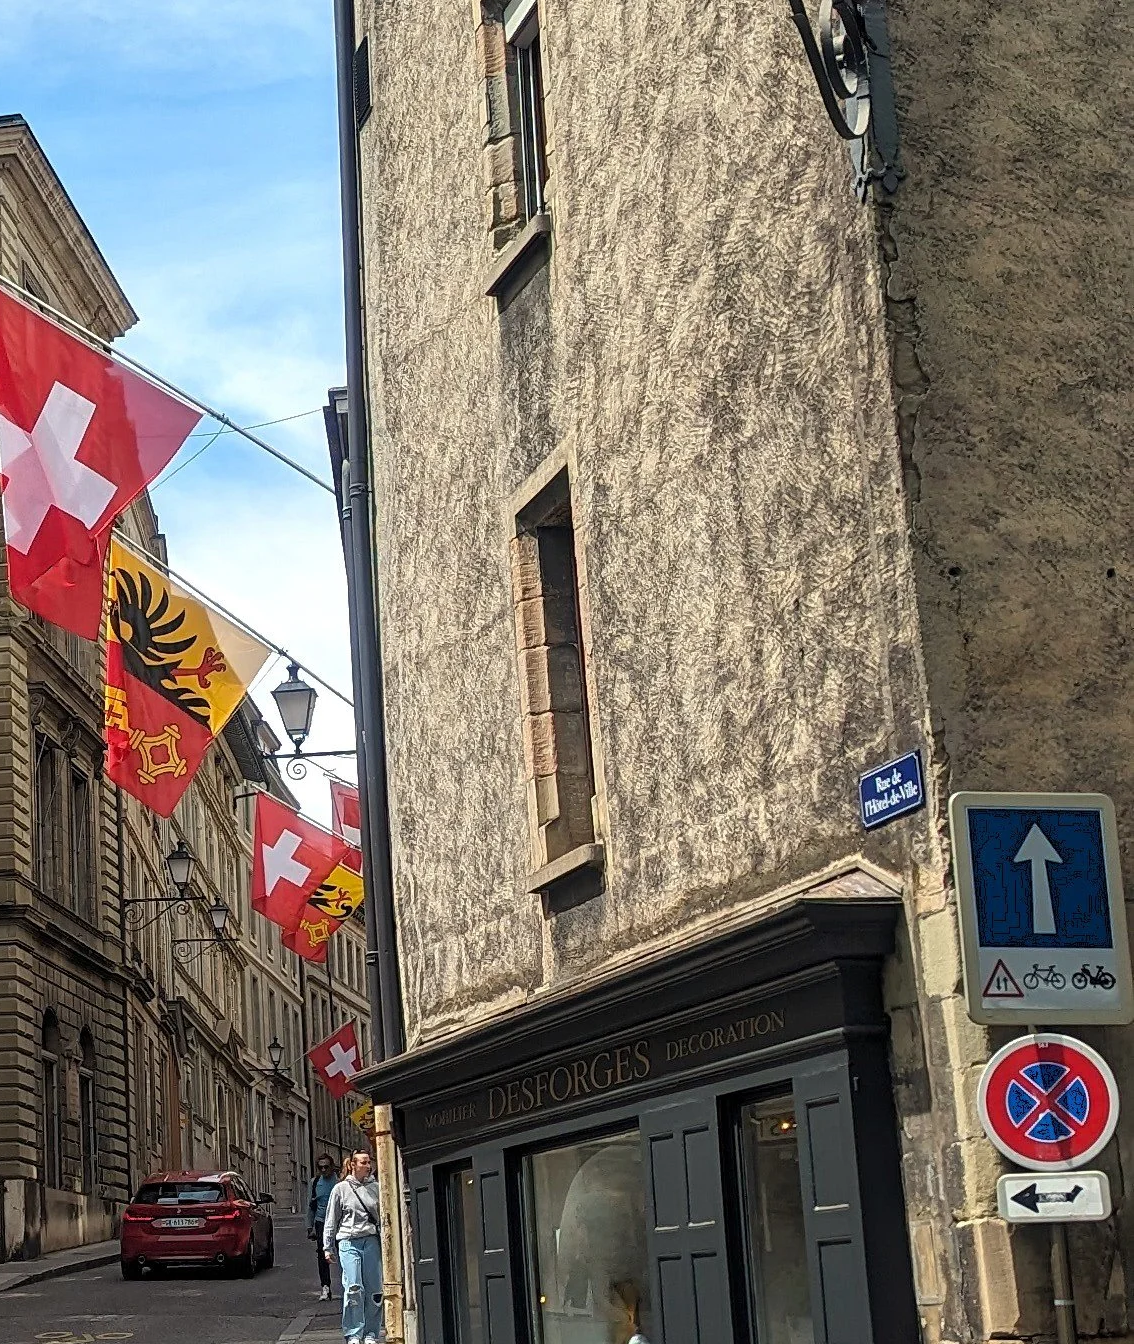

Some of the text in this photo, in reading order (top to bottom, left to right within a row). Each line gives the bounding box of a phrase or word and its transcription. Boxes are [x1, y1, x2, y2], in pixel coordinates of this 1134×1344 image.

[875, 768, 902, 793] Rue de
[488, 1040, 652, 1119] DESFORGES
[666, 1008, 786, 1060] DECORATION
